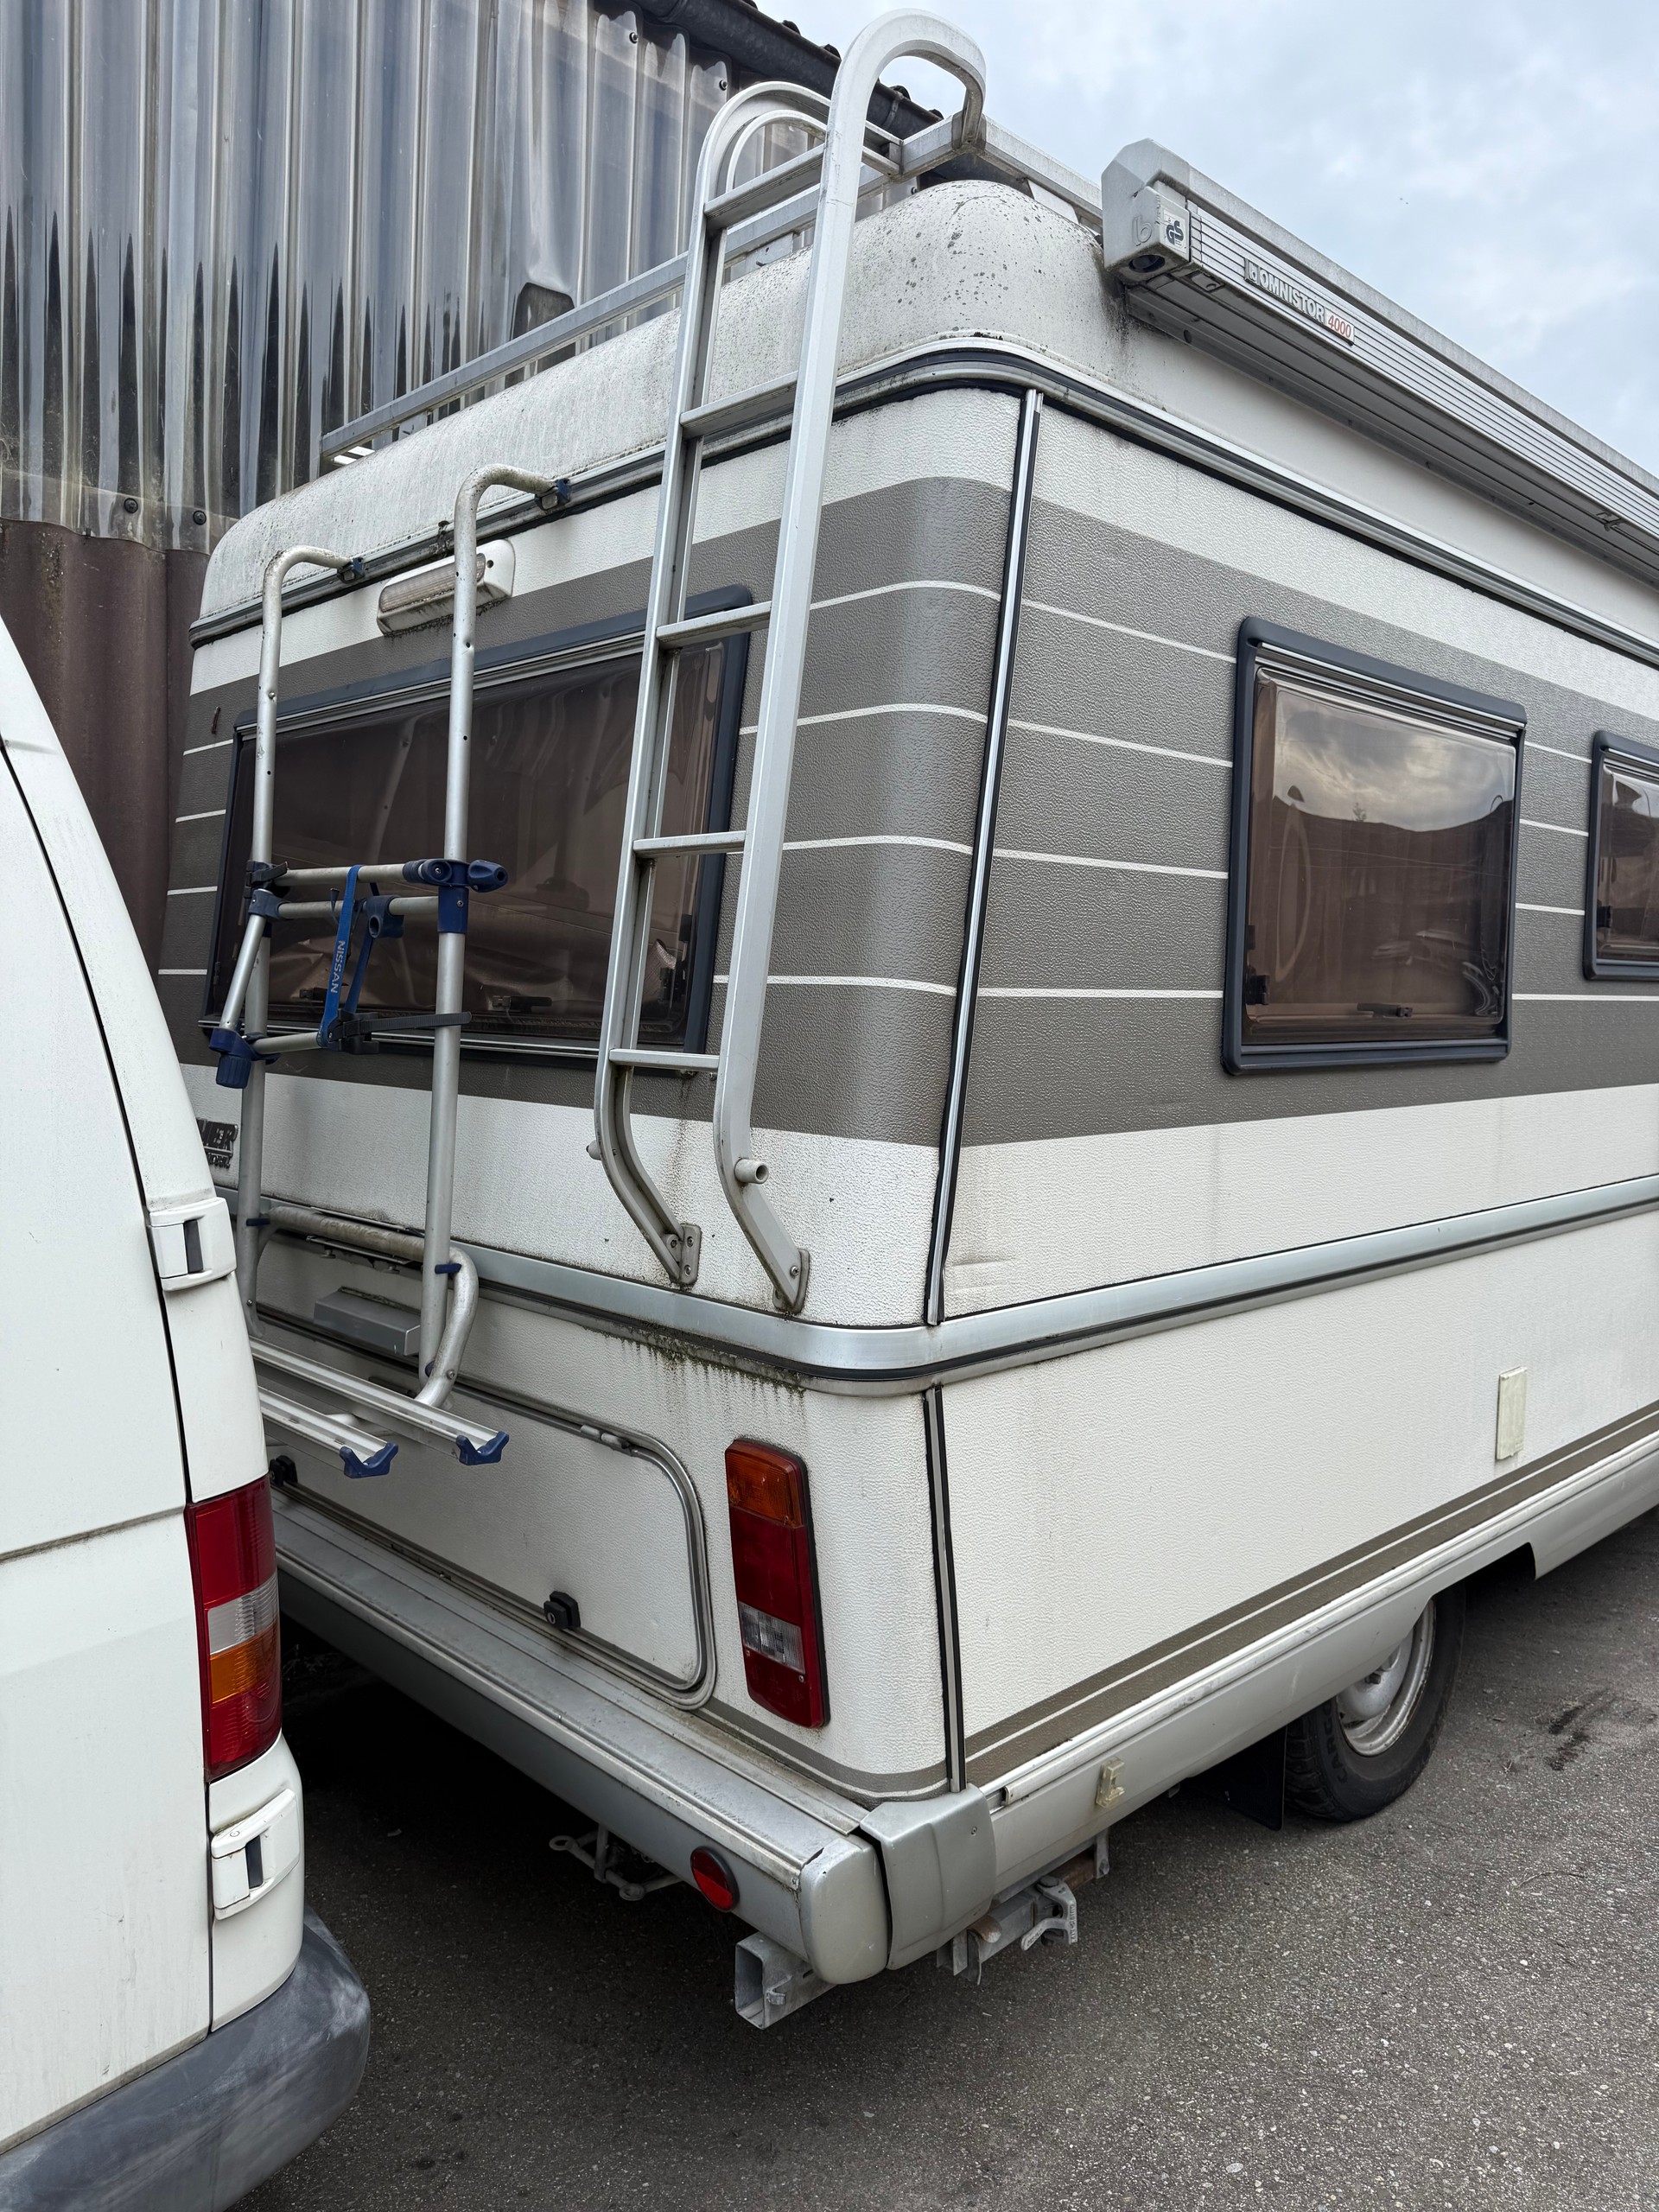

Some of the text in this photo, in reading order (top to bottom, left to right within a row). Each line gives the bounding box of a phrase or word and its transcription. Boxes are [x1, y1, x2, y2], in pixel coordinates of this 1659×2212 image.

[1259, 267, 1325, 325] OMNISTOR
[1327, 314, 1352, 339] 4000
[330, 939, 346, 994] NISSAN
